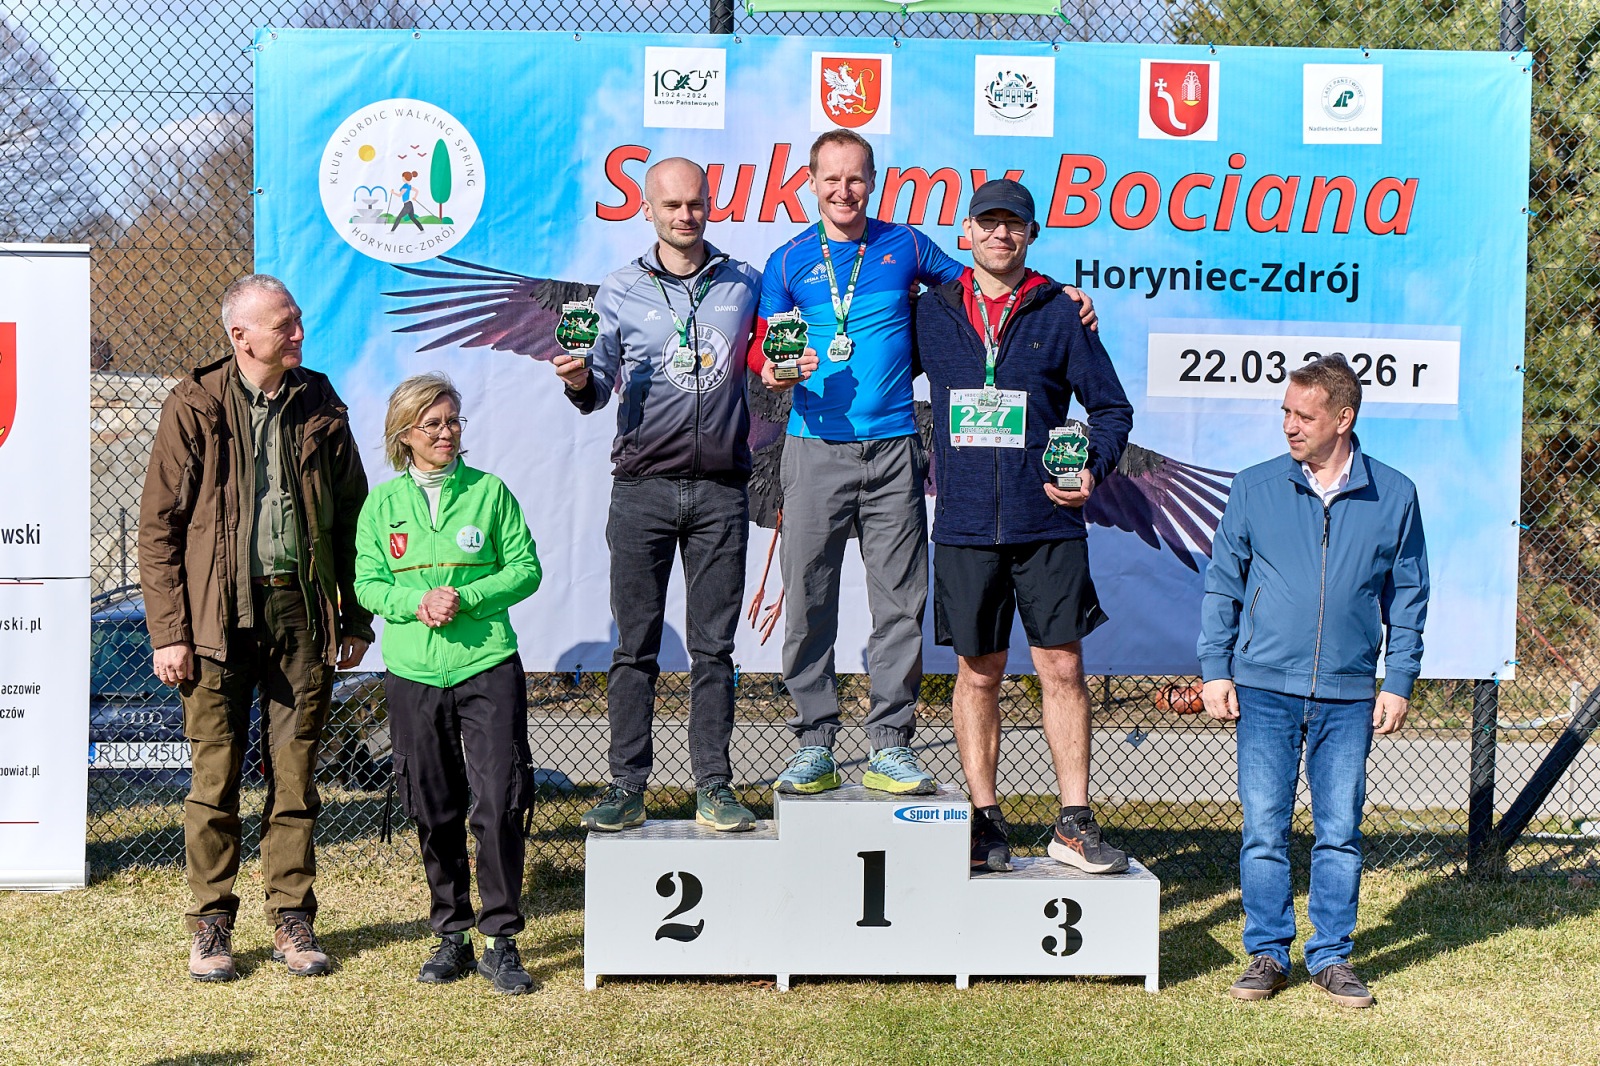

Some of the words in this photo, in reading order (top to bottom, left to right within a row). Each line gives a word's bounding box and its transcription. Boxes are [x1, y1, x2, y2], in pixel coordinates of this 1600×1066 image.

[698, 70, 719, 79] LAT
[676, 99, 719, 107] Państwowych
[329, 150, 344, 185] KLUB
[341, 110, 388, 146] NORDIC
[394, 108, 454, 137] WALKING
[454, 138, 476, 188] SPRING
[1046, 152, 1419, 235] Bociana
[351, 226, 456, 254] HORYNIEC-ZDRÓJ
[1075, 259, 1360, 303] Horyniec-Zdrój
[1412, 362, 1428, 388] r
[960, 406, 1011, 427] 227
[1, 523, 41, 545] wski
[0, 682, 41, 695] aczowie
[99, 743, 141, 762] RLU
[909, 808, 940, 820] sport
[943, 808, 968, 820] plus
[856, 850, 892, 928] 1
[655, 871, 705, 943] 2
[1041, 897, 1083, 957] 3
